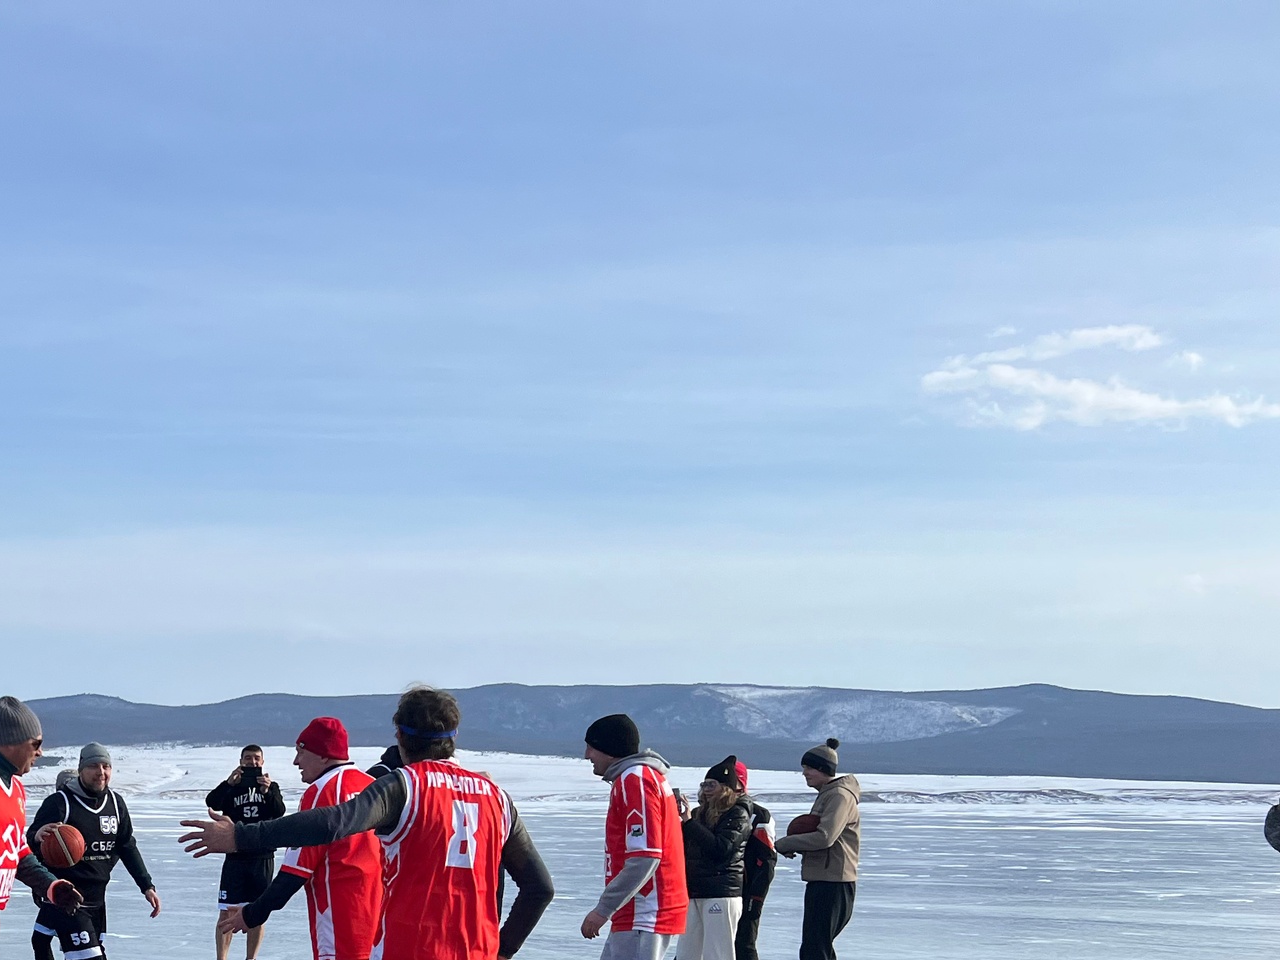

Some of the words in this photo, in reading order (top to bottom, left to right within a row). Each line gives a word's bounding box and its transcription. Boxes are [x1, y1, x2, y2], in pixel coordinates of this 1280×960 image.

[243, 805, 259, 818] 52
[100, 816, 118, 834] 59
[445, 800, 478, 869] 8
[70, 931, 91, 946] 59
